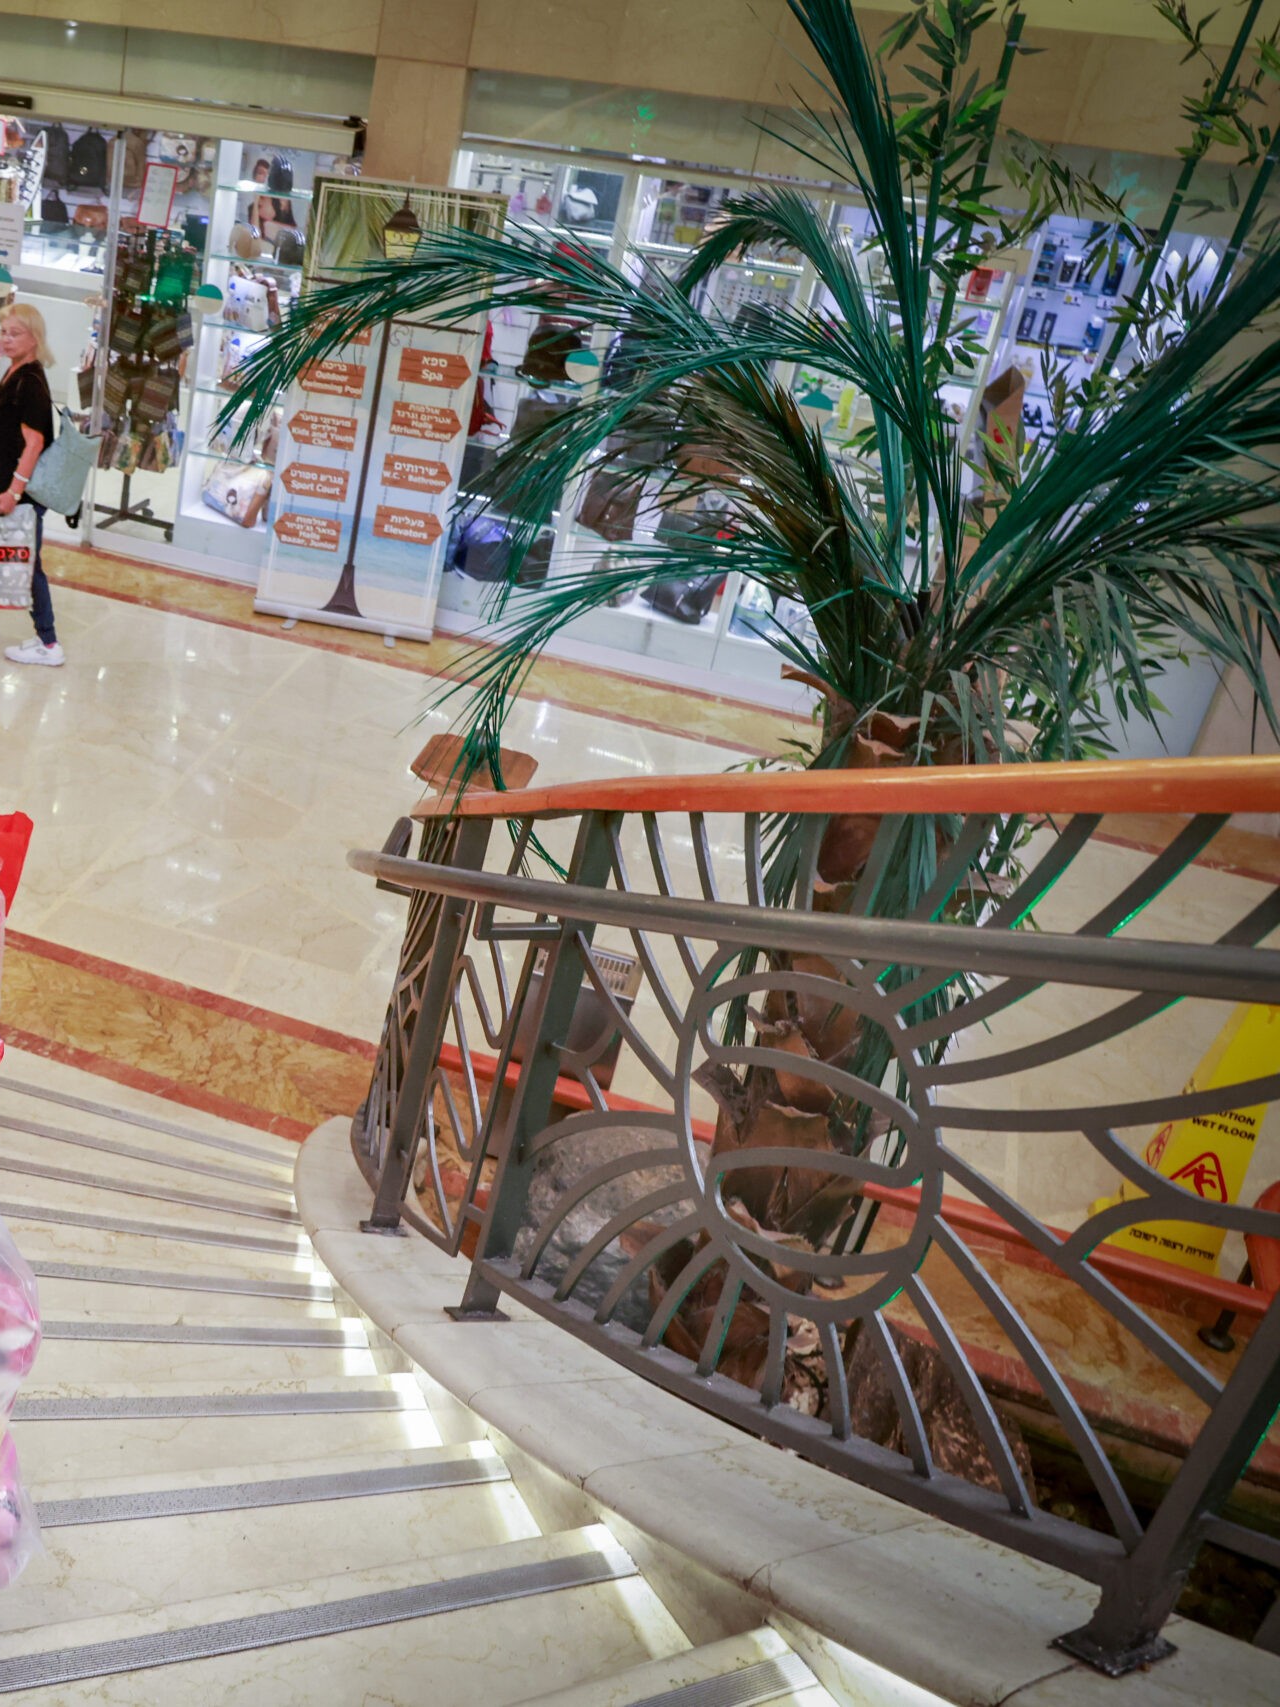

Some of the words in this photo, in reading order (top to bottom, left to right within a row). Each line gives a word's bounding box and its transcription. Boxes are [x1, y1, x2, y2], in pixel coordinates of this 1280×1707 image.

[422, 356, 448, 368] ספא
[315, 370, 349, 382] Outdoor
[421, 369, 444, 382] Spa
[344, 384, 363, 396] Pool
[291, 427, 310, 436] Kids
[312, 431, 328, 439] and
[329, 432, 354, 443] Youth
[290, 469, 318, 480] ספורט
[394, 461, 439, 477] שירותים
[320, 473, 344, 485] מגרש
[408, 474, 447, 487] Bathroom
[290, 480, 314, 491] Sport
[316, 484, 340, 496] Court
[390, 515, 425, 528] מעליות
[383, 524, 428, 540] Elevators
[1216, 1111, 1256, 1126] UTION
[1192, 1117, 1216, 1129] WET
[1218, 1124, 1256, 1142] FLOOR
